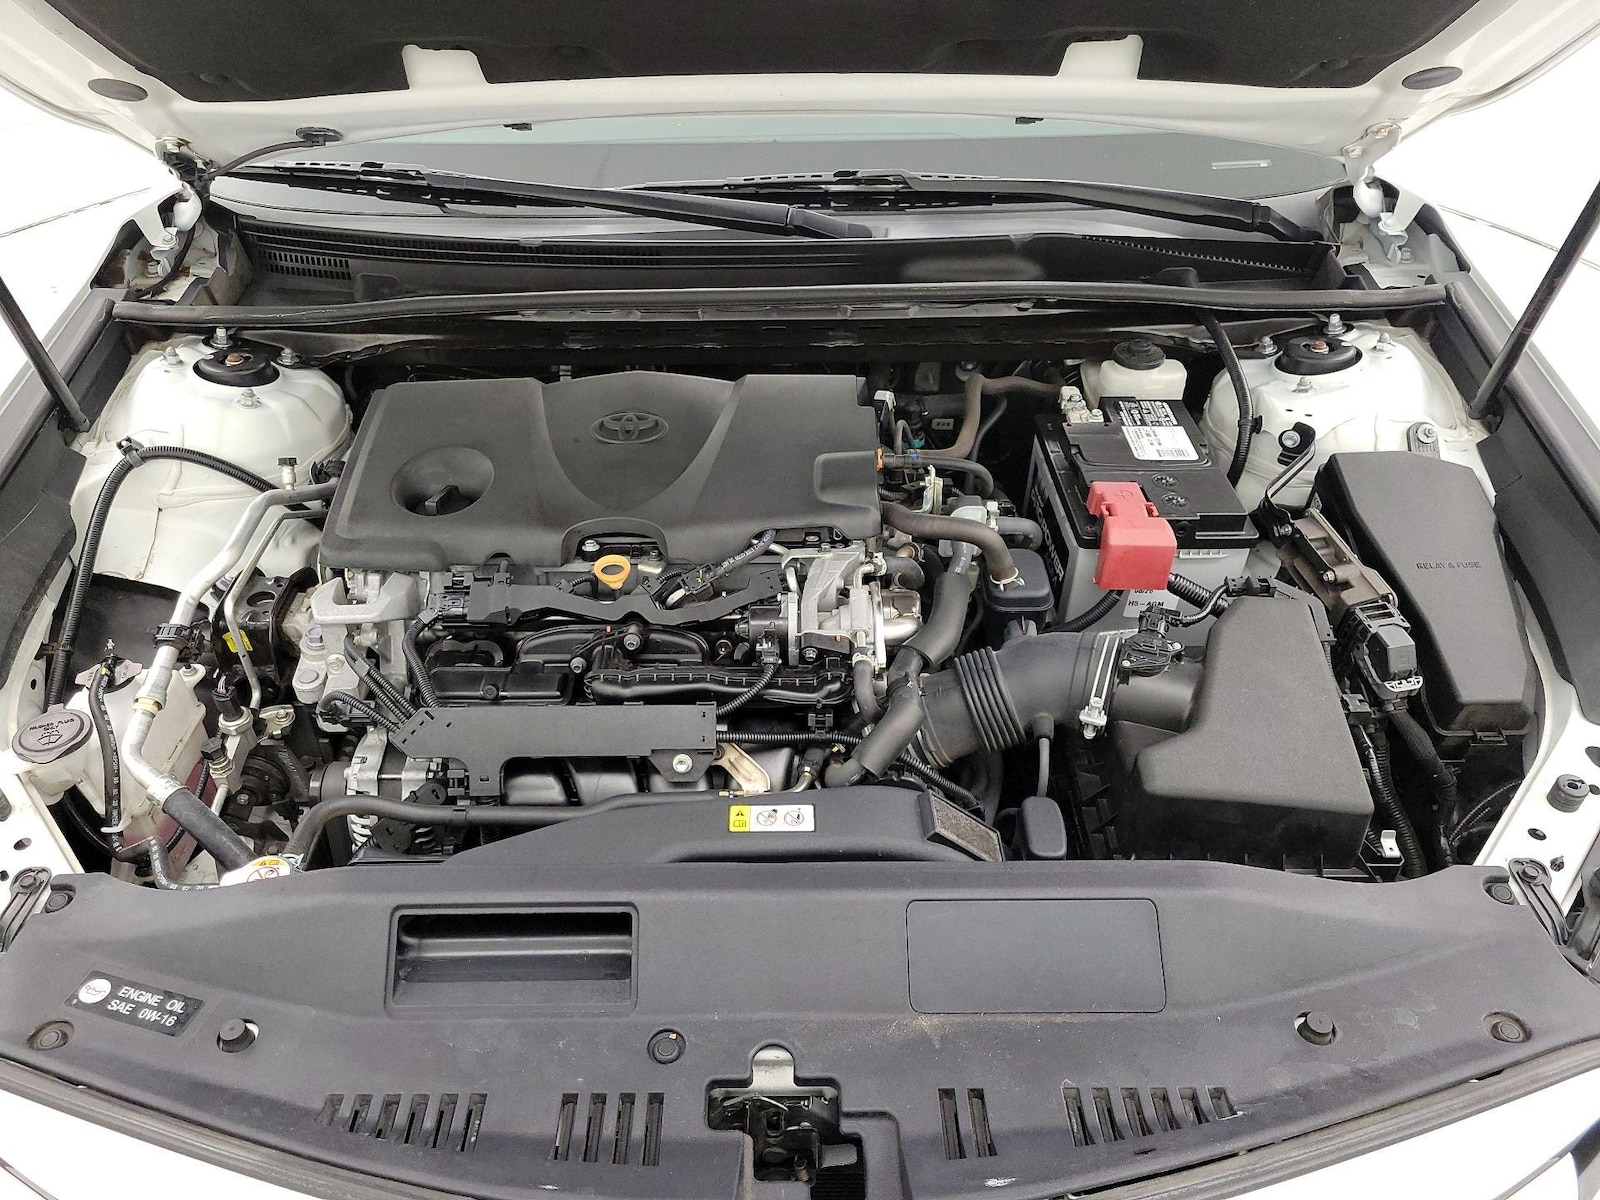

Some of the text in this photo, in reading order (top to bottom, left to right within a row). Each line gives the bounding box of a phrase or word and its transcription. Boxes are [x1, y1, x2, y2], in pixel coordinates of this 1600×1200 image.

[1416, 562, 1446, 570] RELAY
[107, 1000, 178, 1027] SAE 0W-16
[118, 986, 187, 1014] ENGINE OIL
